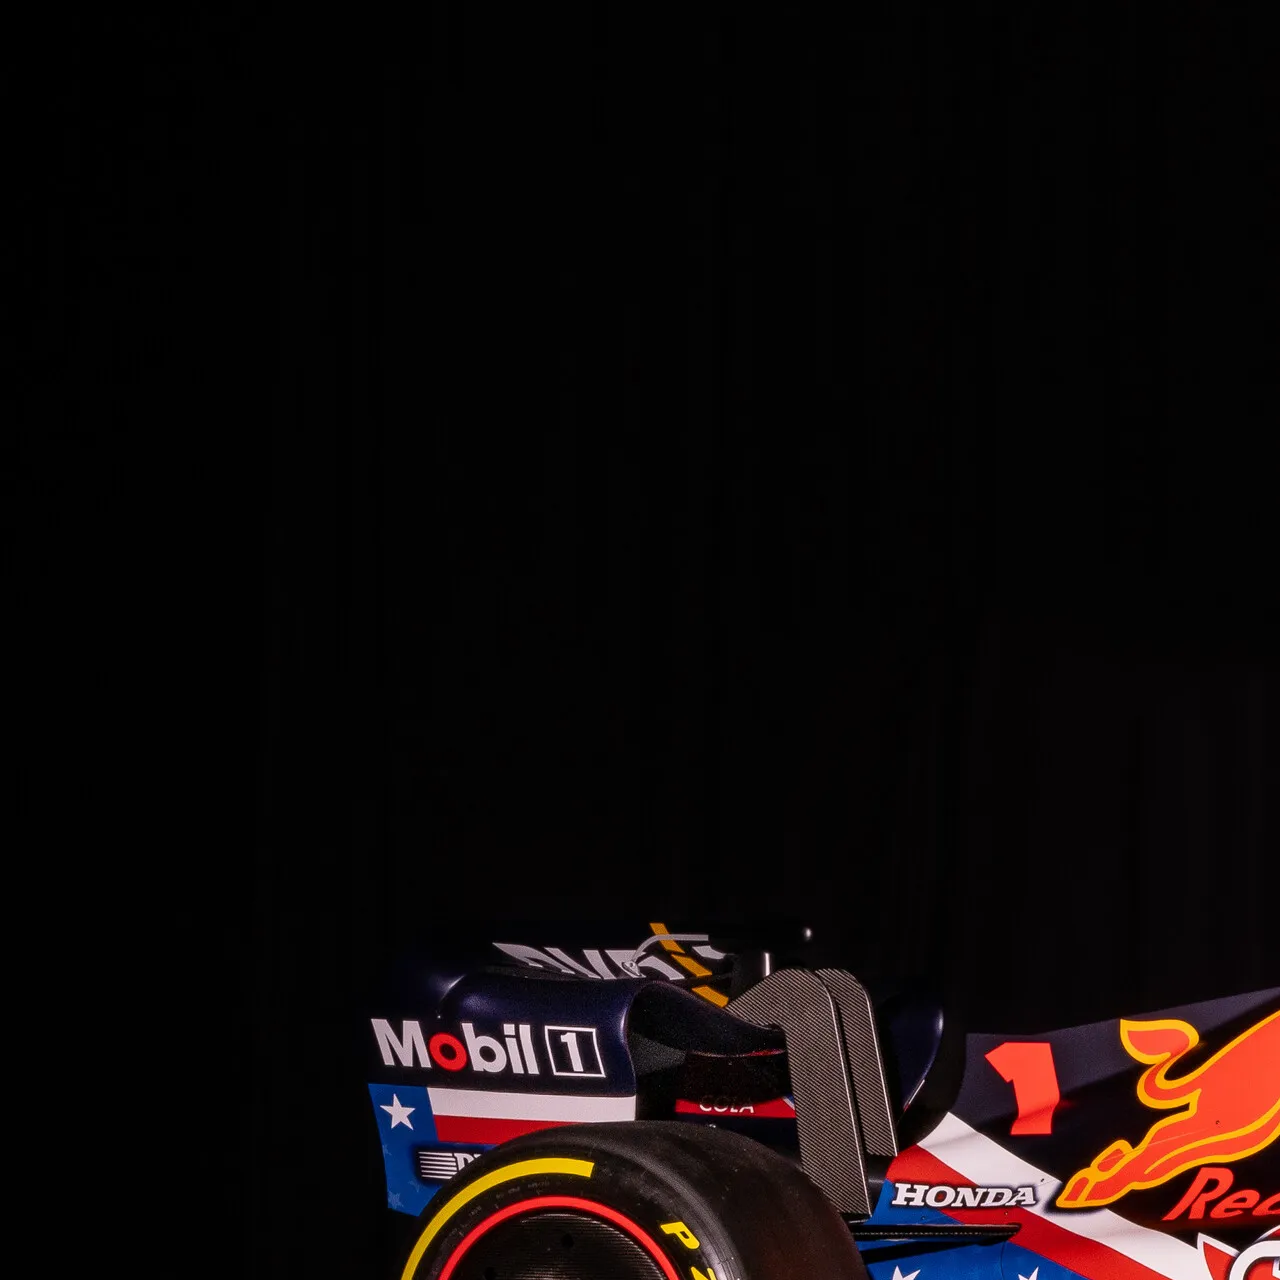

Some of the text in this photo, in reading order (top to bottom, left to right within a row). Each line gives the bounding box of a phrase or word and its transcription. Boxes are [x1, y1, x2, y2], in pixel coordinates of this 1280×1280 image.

[371, 1019, 539, 1074] Mobil
[985, 1042, 1060, 1134] 1
[892, 1183, 1036, 1208] HONDA
[660, 1221, 700, 1250] P
